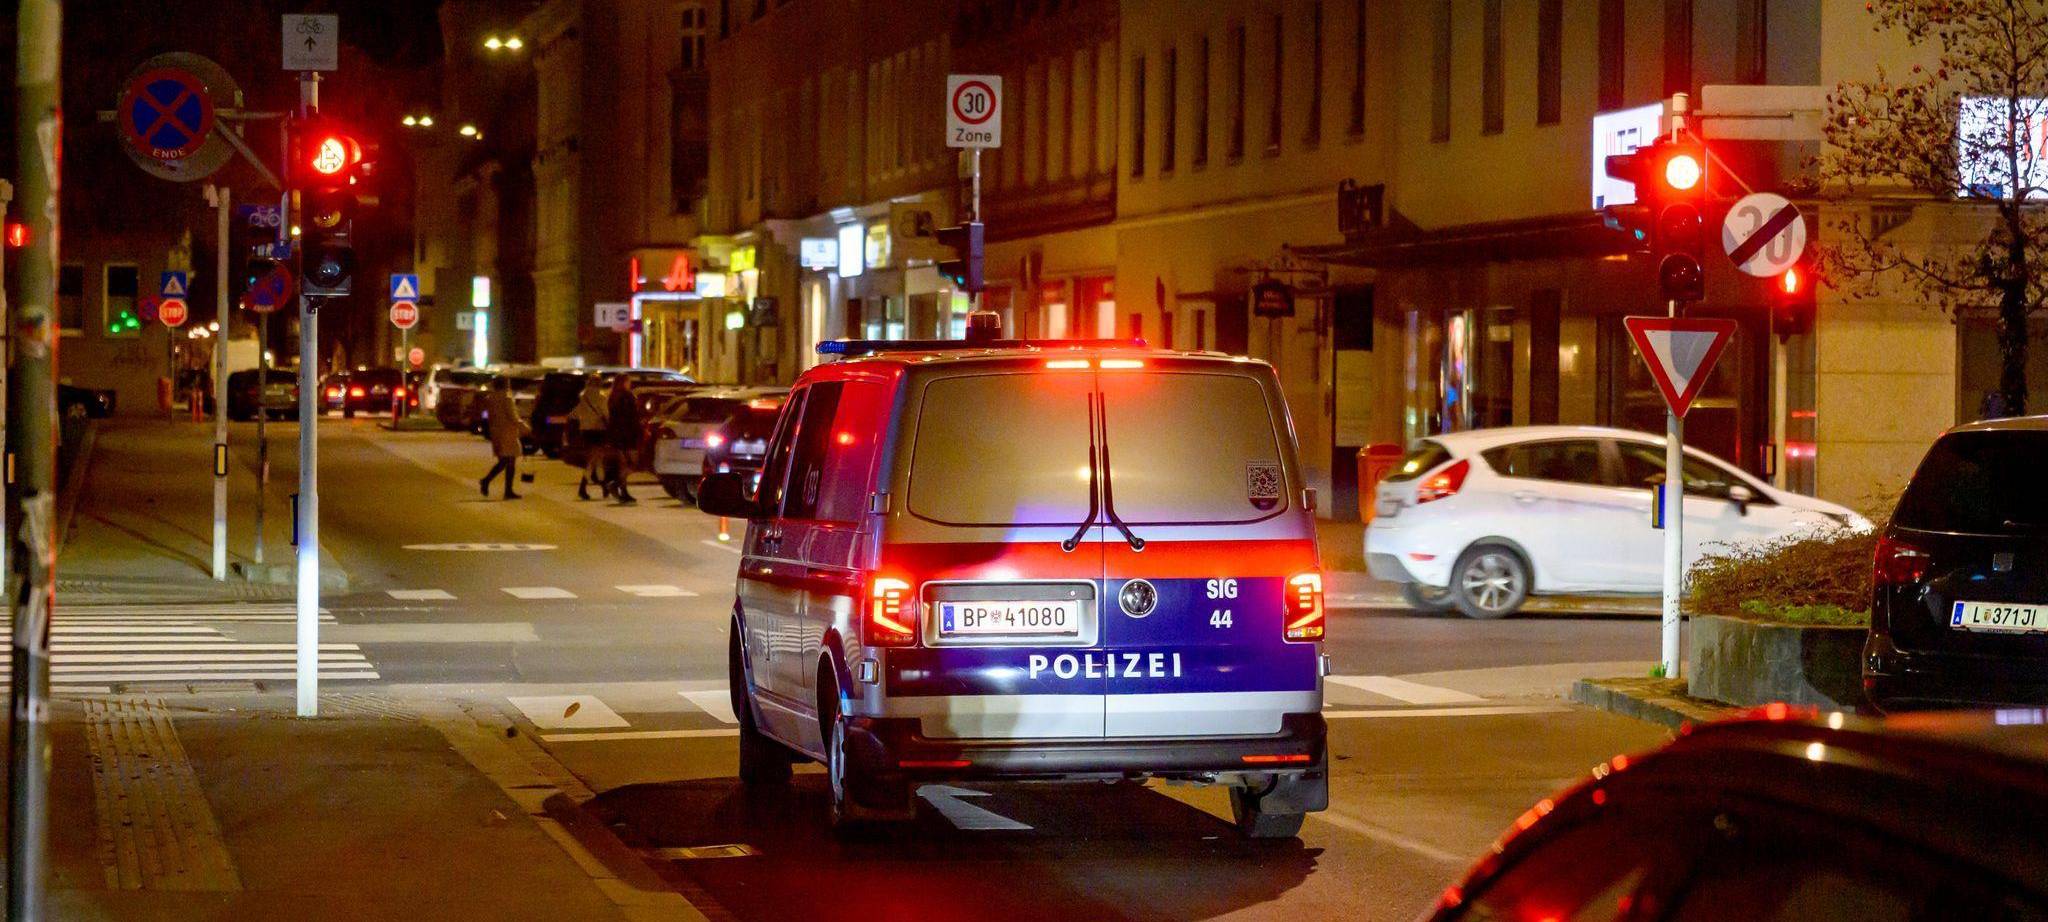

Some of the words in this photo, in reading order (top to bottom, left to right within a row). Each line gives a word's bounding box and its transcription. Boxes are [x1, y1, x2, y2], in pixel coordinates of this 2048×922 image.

[964, 93, 985, 113] 30
[956, 128, 992, 142] Zone
[152, 148, 186, 159] ENDE
[1737, 205, 1794, 265] 30
[1206, 579, 1238, 599] SIG
[963, 608, 988, 627] BP
[1005, 608, 1065, 627] 41080
[1209, 609, 1233, 629] 44
[1973, 606, 1980, 623] L
[1992, 607, 2037, 626] 371JI
[1029, 653, 1181, 679] POLIZEI
